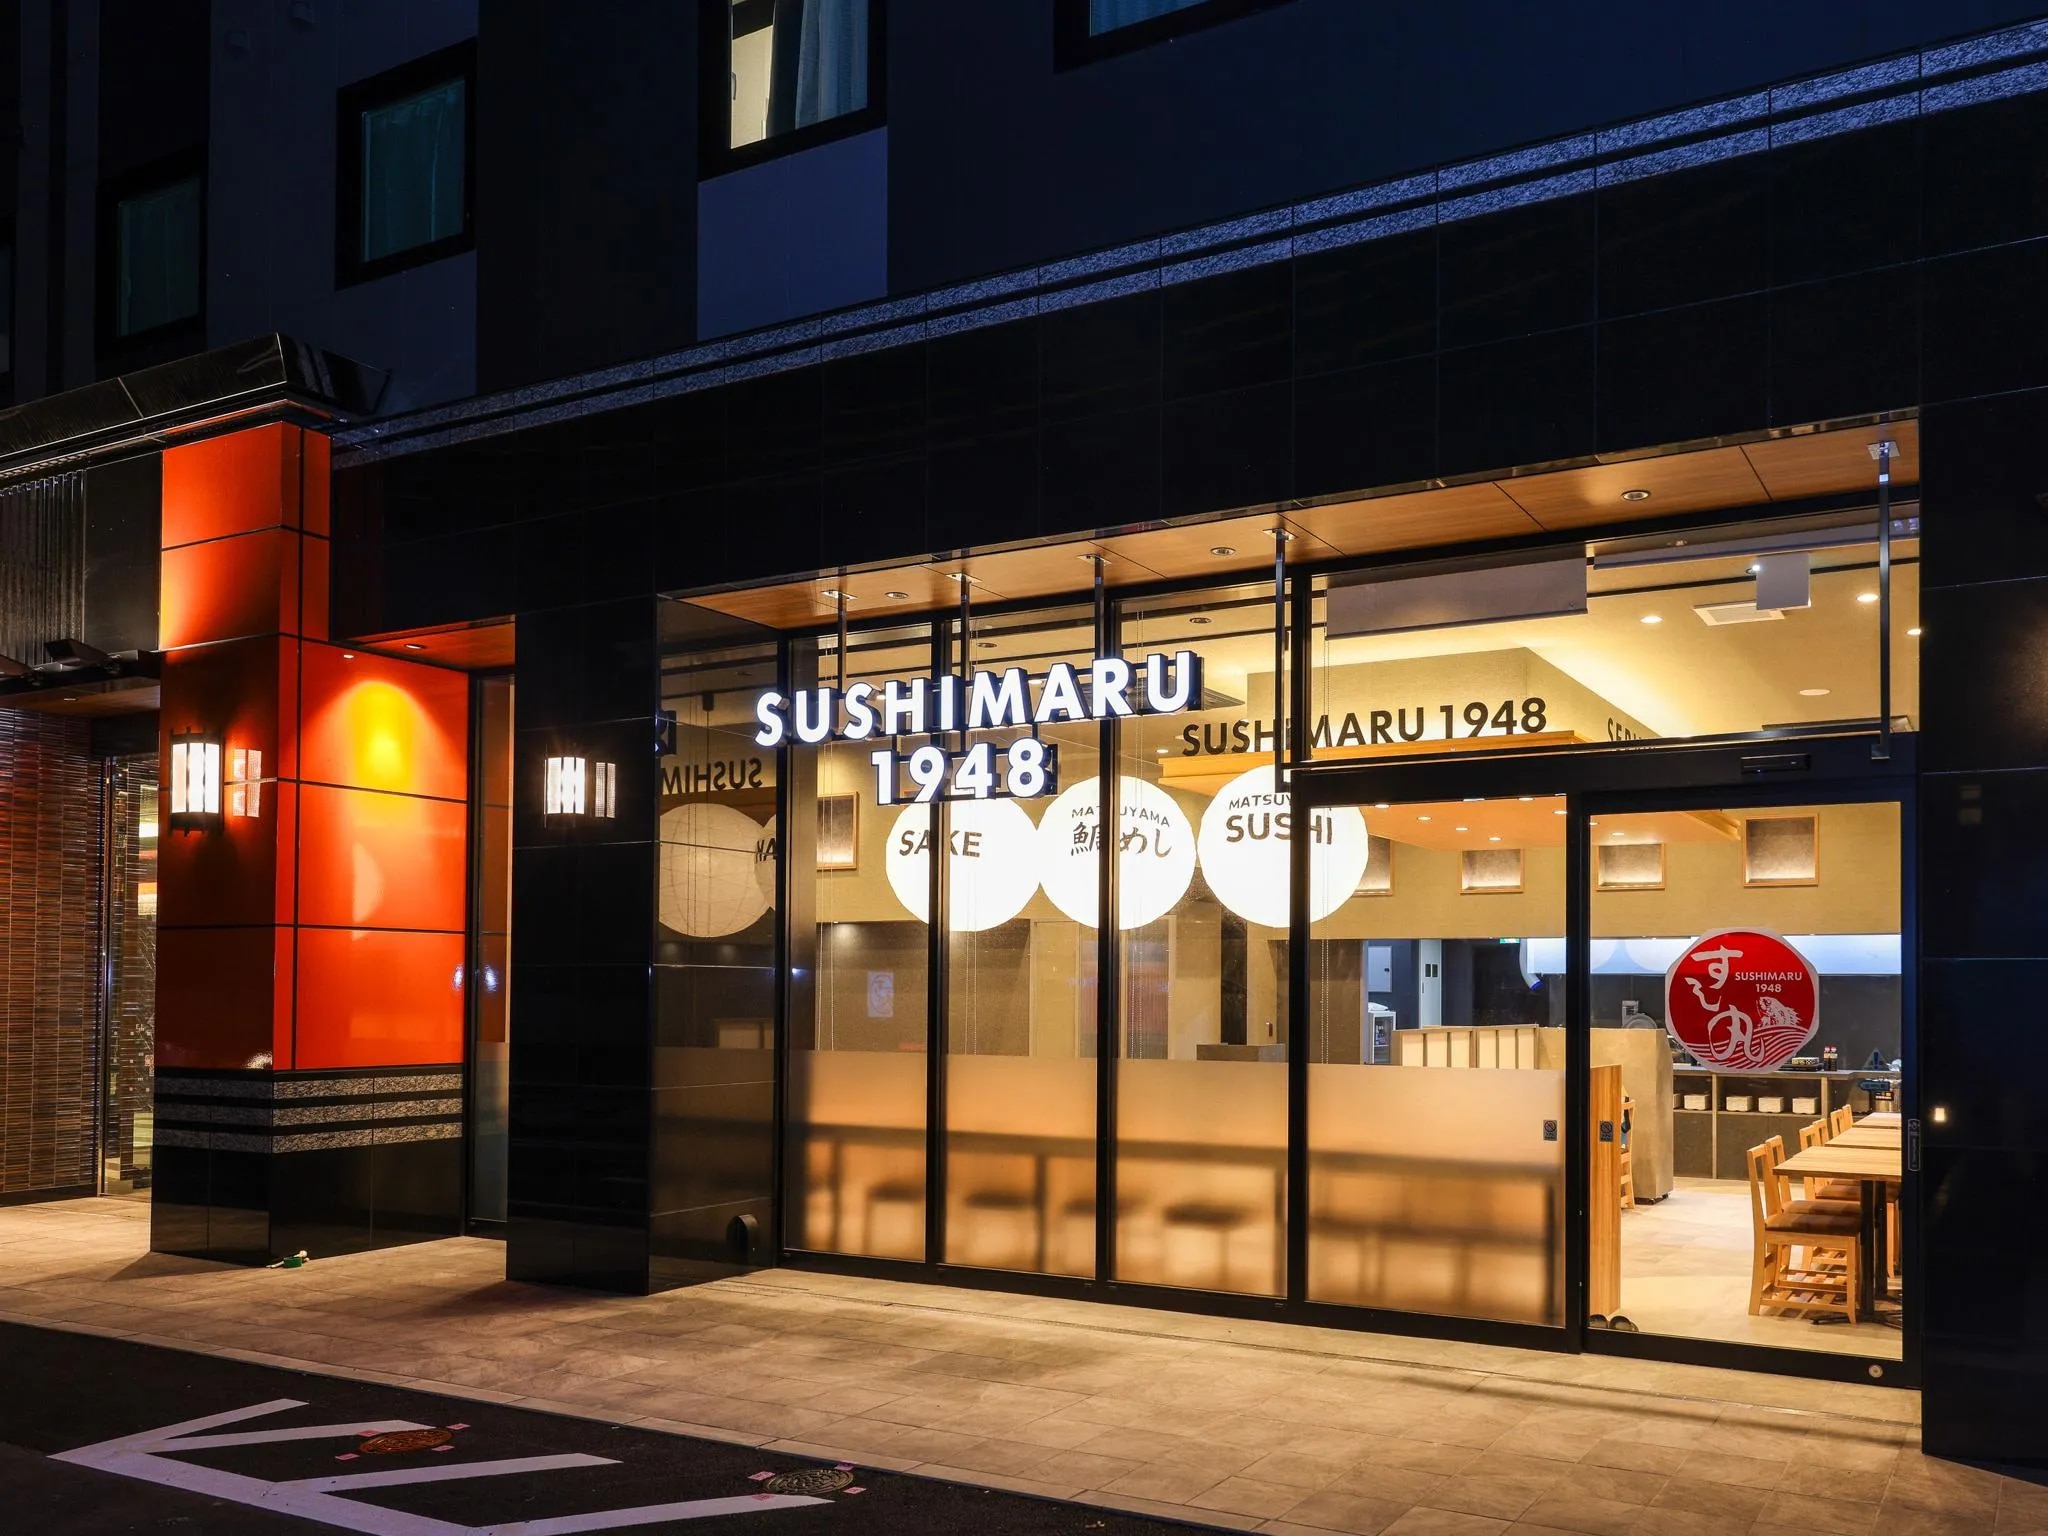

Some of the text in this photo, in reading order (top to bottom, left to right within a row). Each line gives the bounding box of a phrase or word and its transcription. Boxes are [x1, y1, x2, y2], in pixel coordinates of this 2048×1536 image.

[754, 650, 1198, 748] SUSHIMARU
[1439, 697, 1547, 740] 1948
[871, 737, 1046, 806] 1948
[1734, 971, 1803, 982] SUSHIMARU
[1755, 983, 1782, 993] 1948
